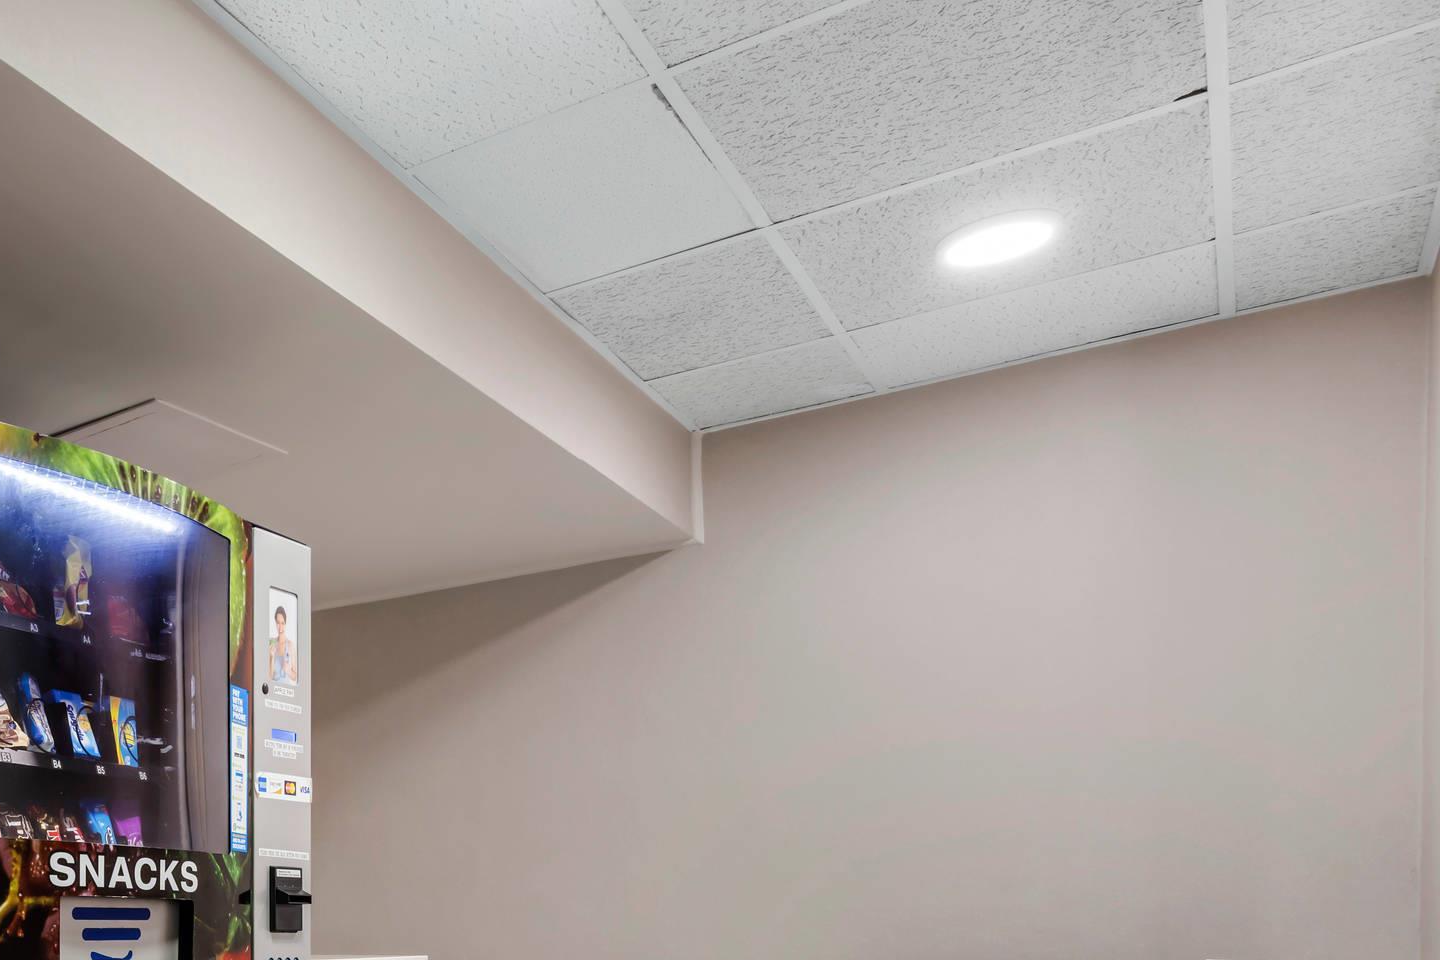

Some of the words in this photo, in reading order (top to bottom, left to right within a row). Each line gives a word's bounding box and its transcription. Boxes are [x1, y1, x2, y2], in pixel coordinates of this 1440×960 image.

[52, 759, 62, 769] B4
[96, 765, 105, 775] B5
[48, 851, 199, 893] SNACKS
